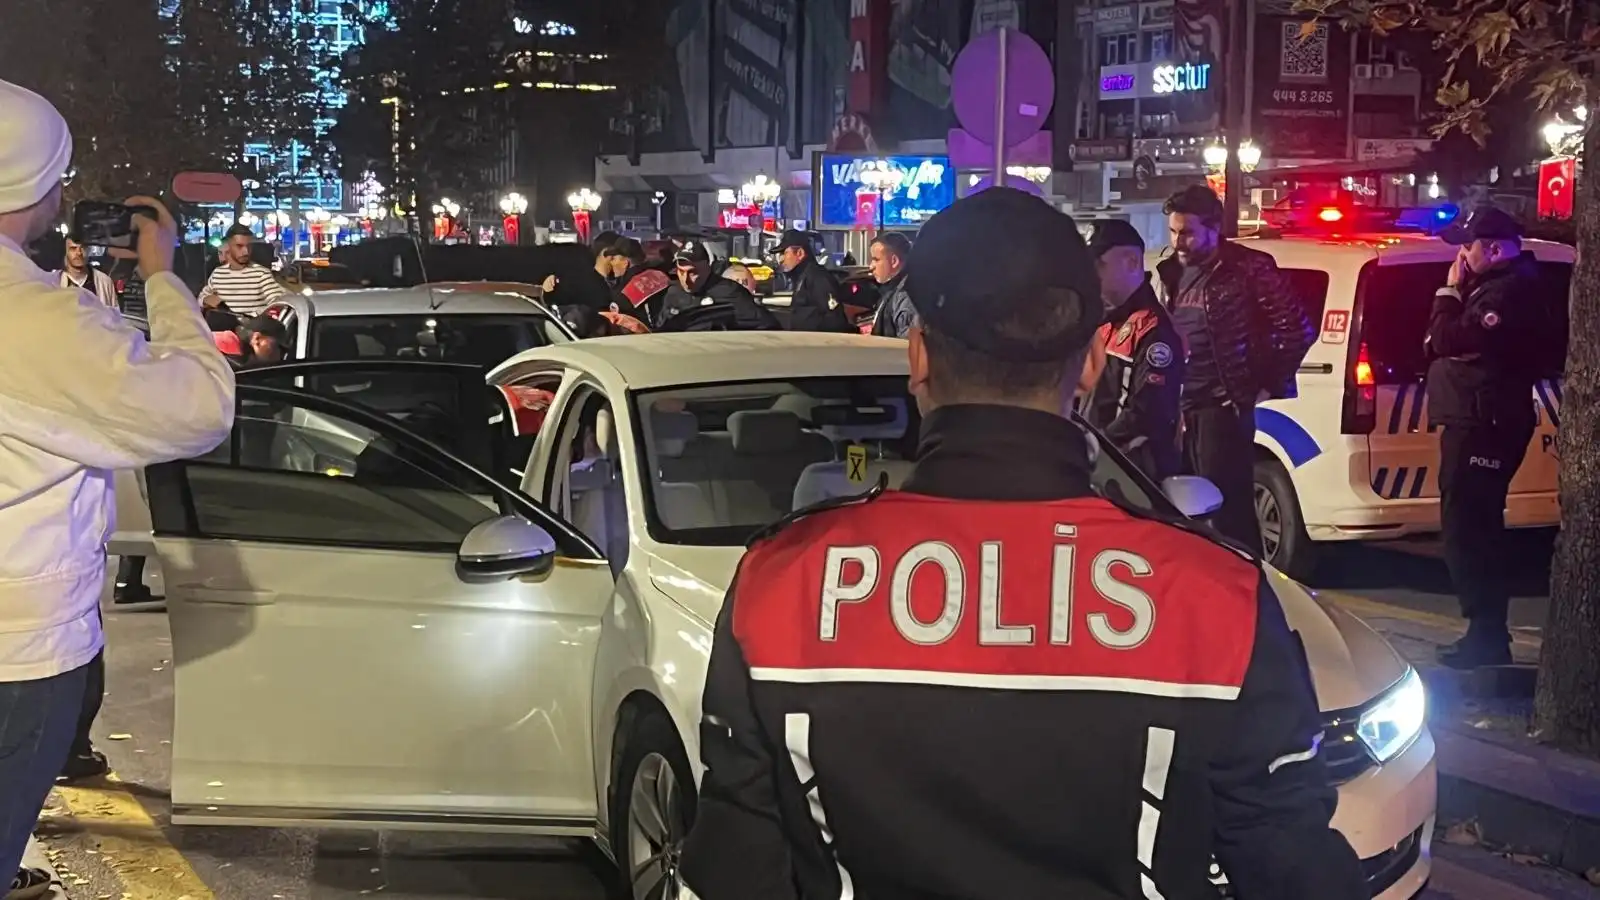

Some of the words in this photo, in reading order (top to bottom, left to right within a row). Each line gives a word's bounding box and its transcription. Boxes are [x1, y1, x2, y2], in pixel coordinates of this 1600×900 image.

[1152, 62, 1211, 93] ssctur
[1273, 89, 1297, 102] 444
[1327, 313, 1345, 330] 112
[818, 523, 1156, 650] POLİS
